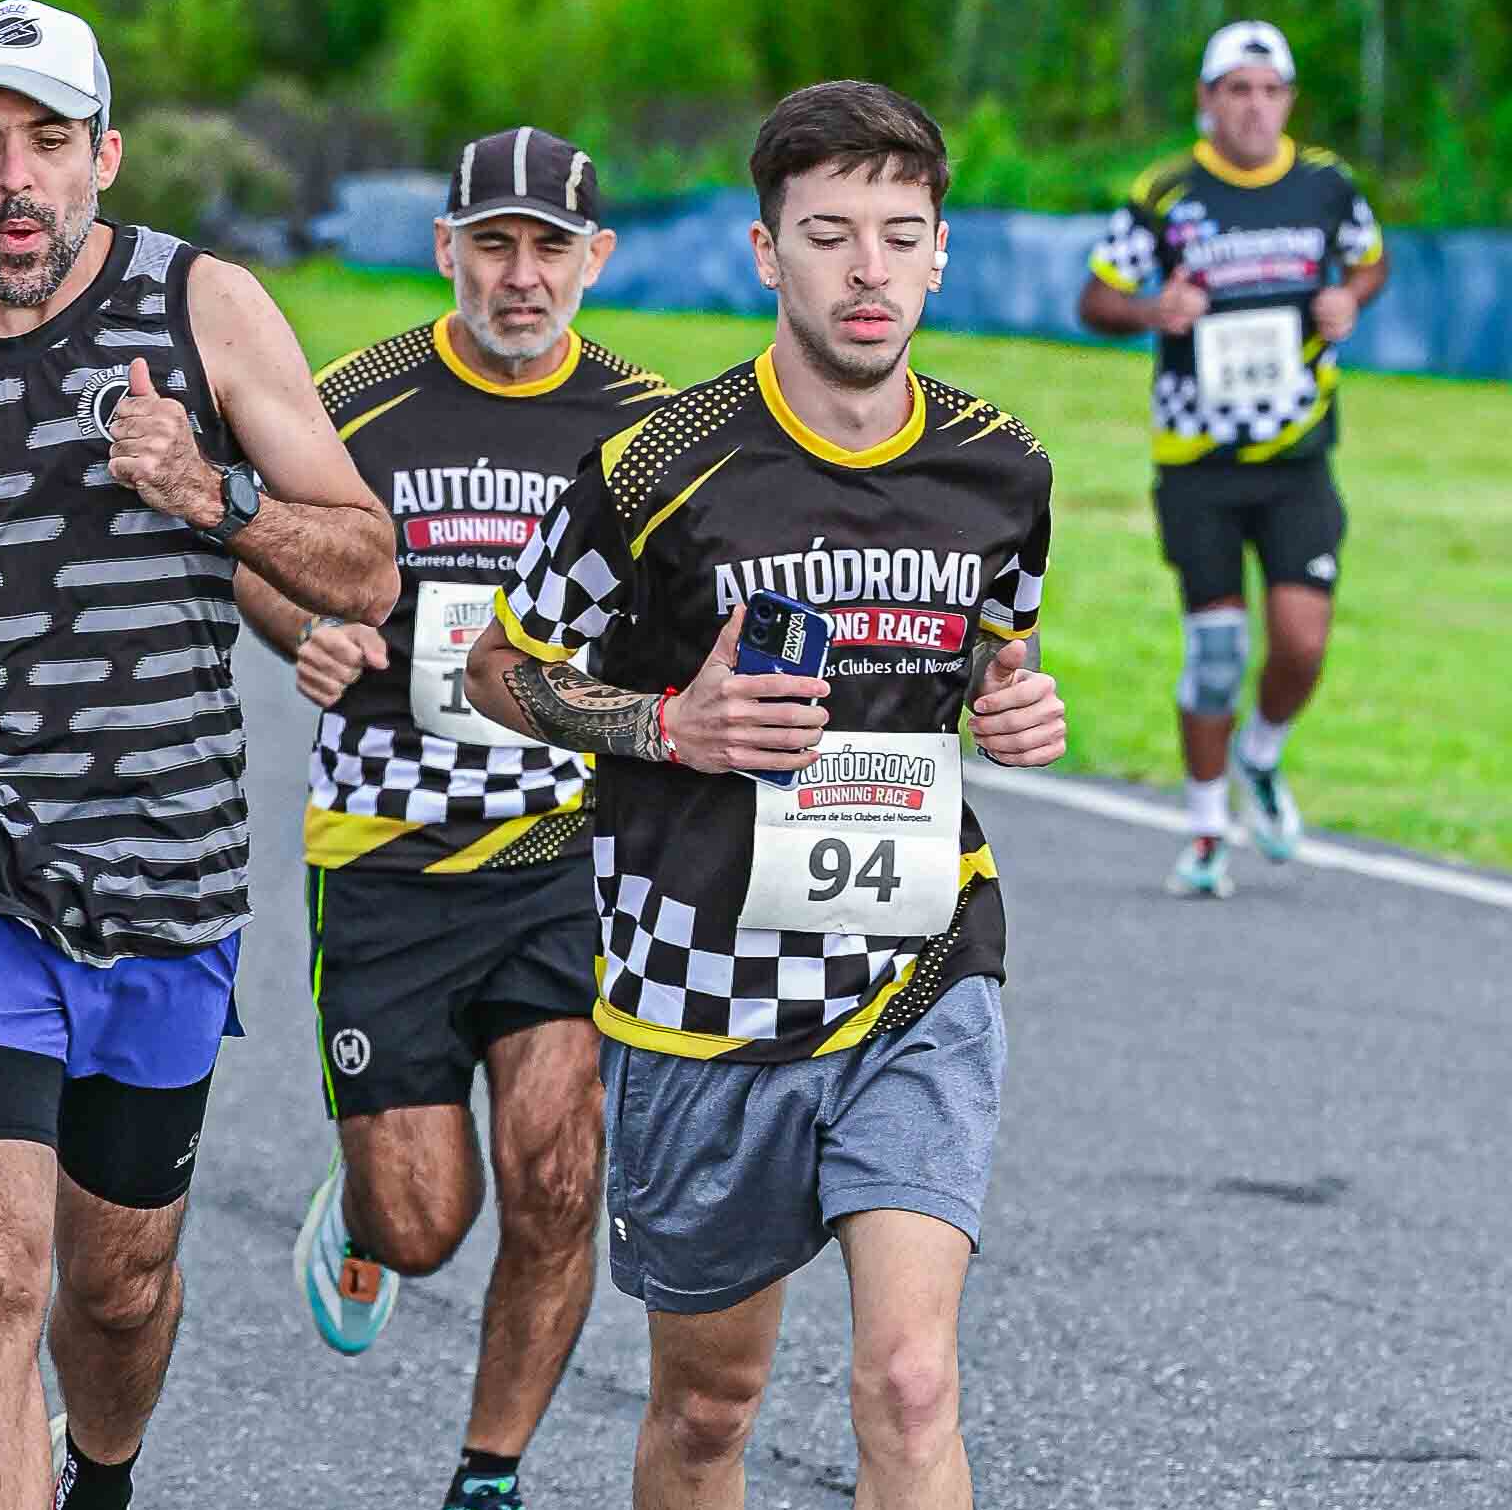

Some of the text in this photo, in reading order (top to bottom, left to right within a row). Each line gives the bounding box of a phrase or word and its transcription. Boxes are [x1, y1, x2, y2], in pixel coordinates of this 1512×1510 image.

[77, 364, 123, 434] RUNNING TEAM
[393, 457, 576, 516] AUTÓDRO
[428, 519, 526, 545] RUNNING
[406, 552, 455, 567] Carrera
[456, 552, 475, 567] de
[476, 553, 496, 569] los
[715, 537, 981, 615] AUTÓDROMO
[784, 614, 803, 660] FAWNA
[878, 613, 945, 645] RACE
[838, 658, 892, 676] Clubes
[895, 658, 920, 674] del
[813, 786, 911, 806] RUNNING RACE
[784, 812, 932, 823] La Carrera de los Clubes del Noroeste
[808, 837, 902, 903] 94
